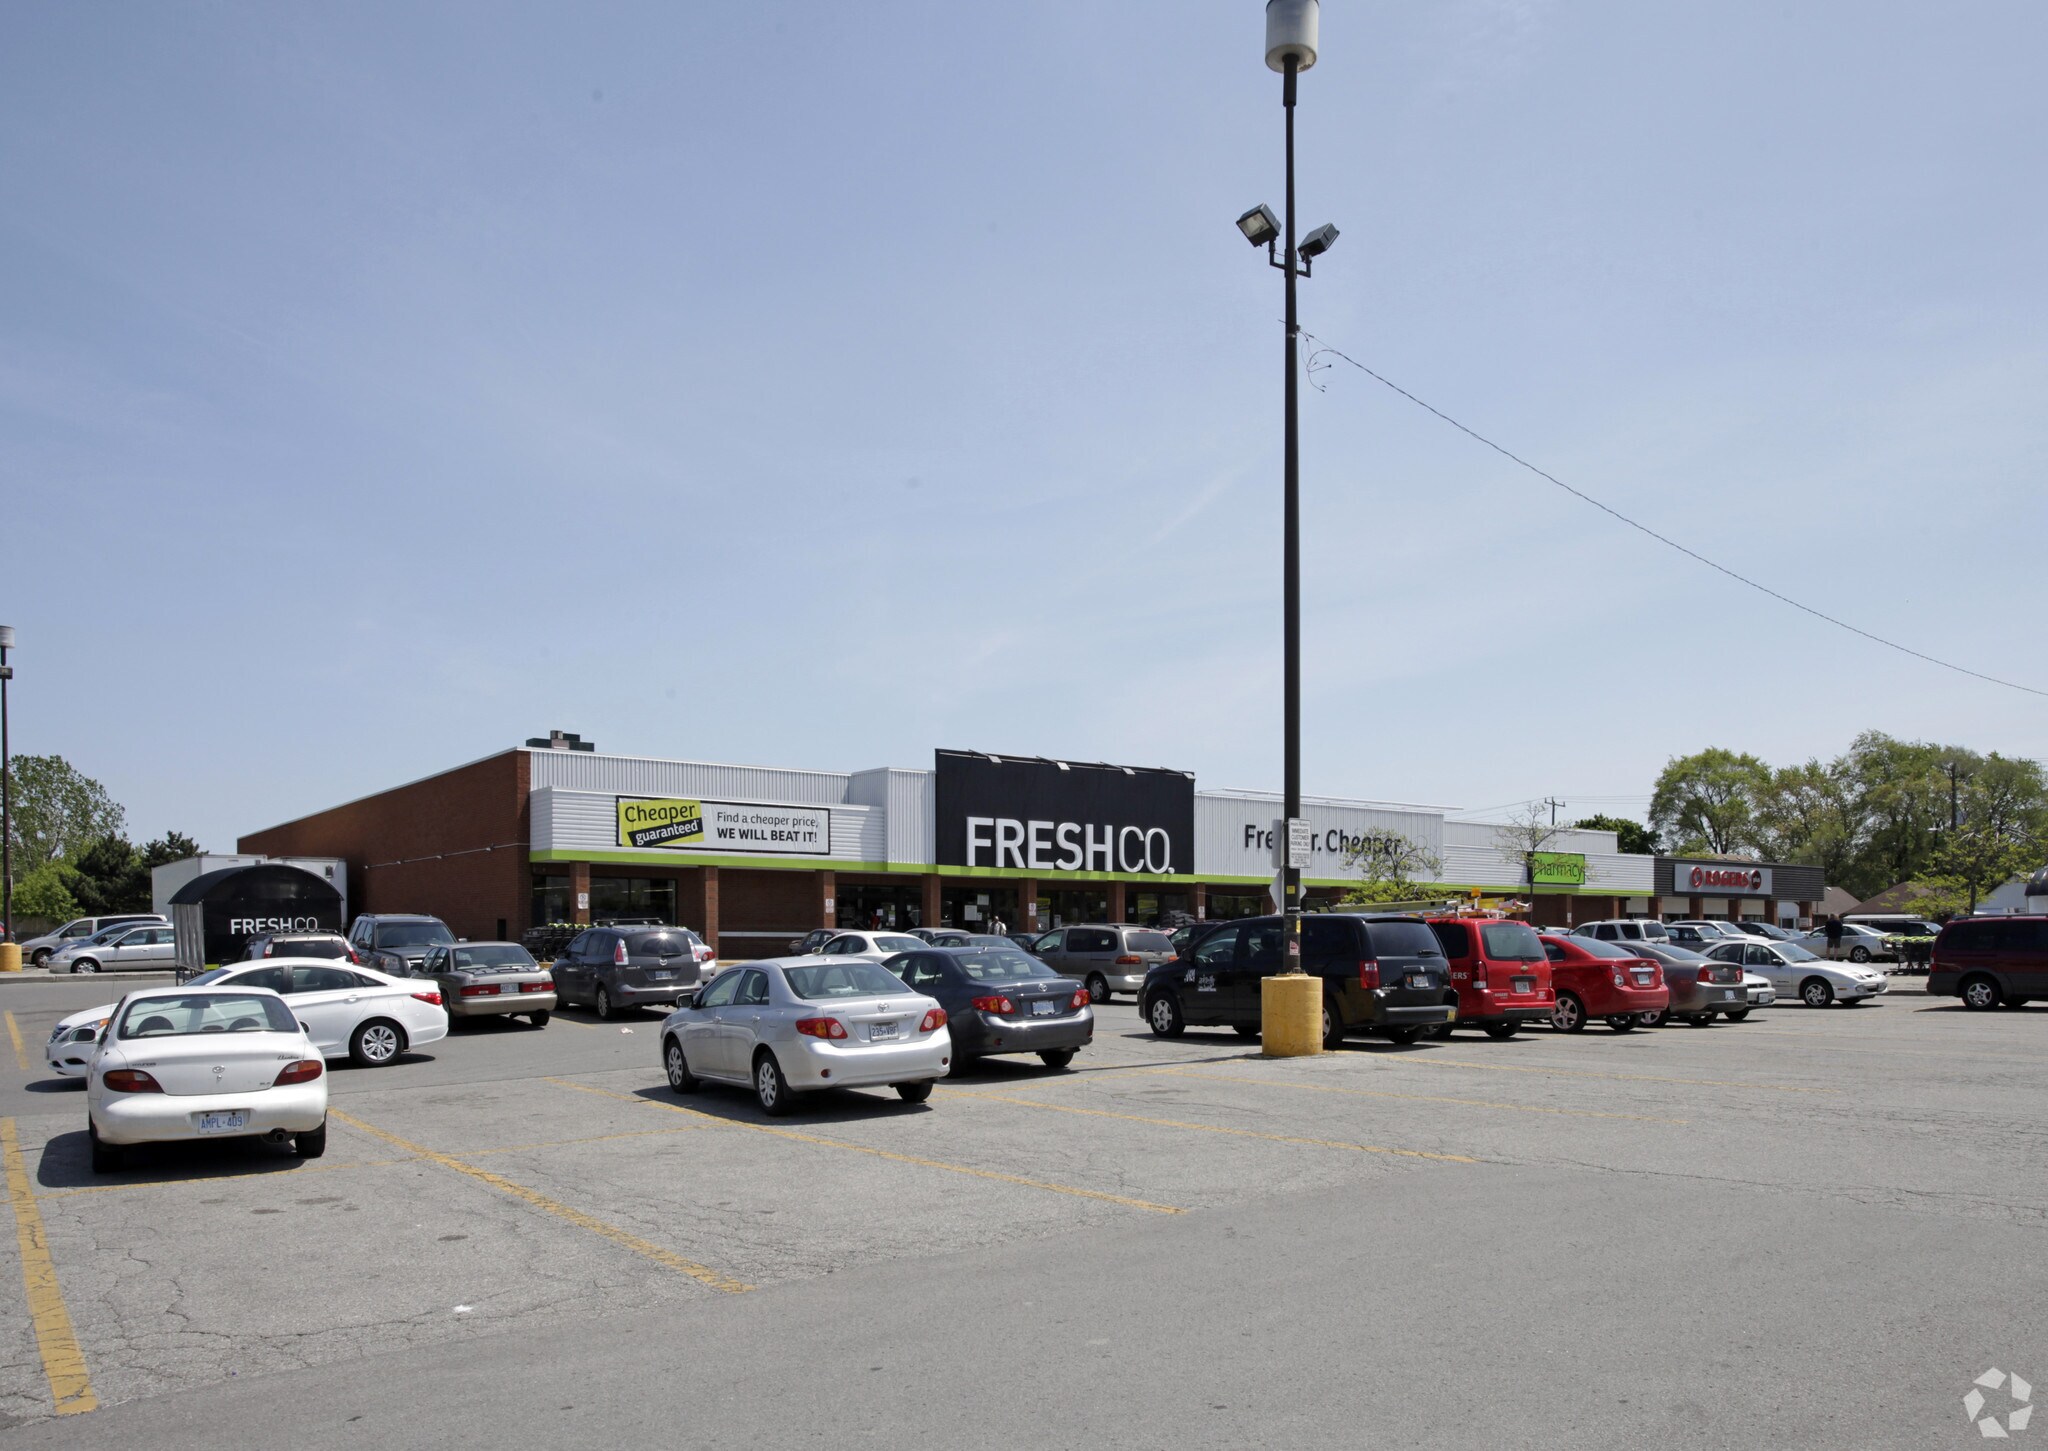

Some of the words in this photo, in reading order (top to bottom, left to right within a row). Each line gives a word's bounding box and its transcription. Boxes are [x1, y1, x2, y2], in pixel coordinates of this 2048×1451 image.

[624, 804, 696, 823] Cheaper
[717, 811, 739, 823] Find
[750, 814, 790, 828] cheaper
[792, 816, 819, 829] price,
[635, 819, 700, 846] guaranteed
[717, 827, 736, 839] WE
[738, 828, 768, 841] WILL
[771, 830, 800, 842] BEAT
[803, 831, 818, 843] IT!
[1244, 824, 1322, 852] Frer.
[1705, 870, 1749, 887] ROGERS
[227, 1116, 243, 1127] 409
